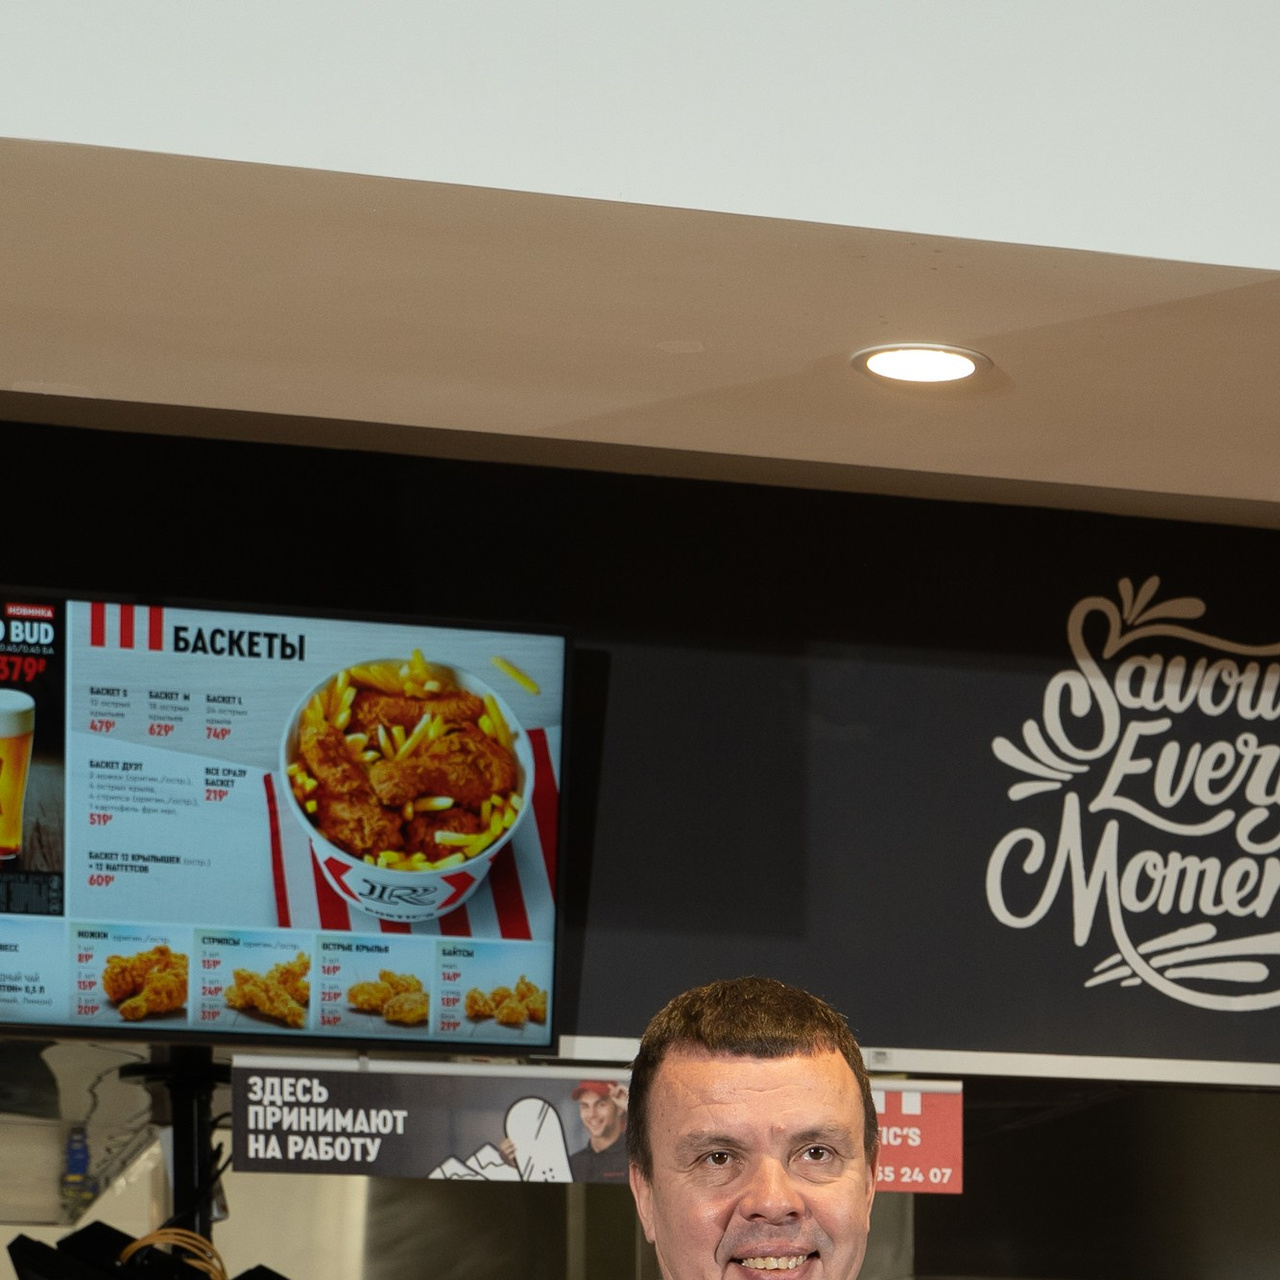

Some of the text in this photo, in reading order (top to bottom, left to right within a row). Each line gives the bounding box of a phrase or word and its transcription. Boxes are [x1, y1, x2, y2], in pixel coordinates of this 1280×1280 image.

[9, 620, 55, 645] BUD
[173, 625, 306, 662] БАСКЕТЫ
[247, 1076, 329, 1104] ЗДЕСЬ
[247, 1105, 408, 1135] ПРИНИМАЮТ
[247, 1133, 382, 1163] НА РАБОТУ
[900, 1166, 924, 1184] 24
[928, 1167, 953, 1185] 07
